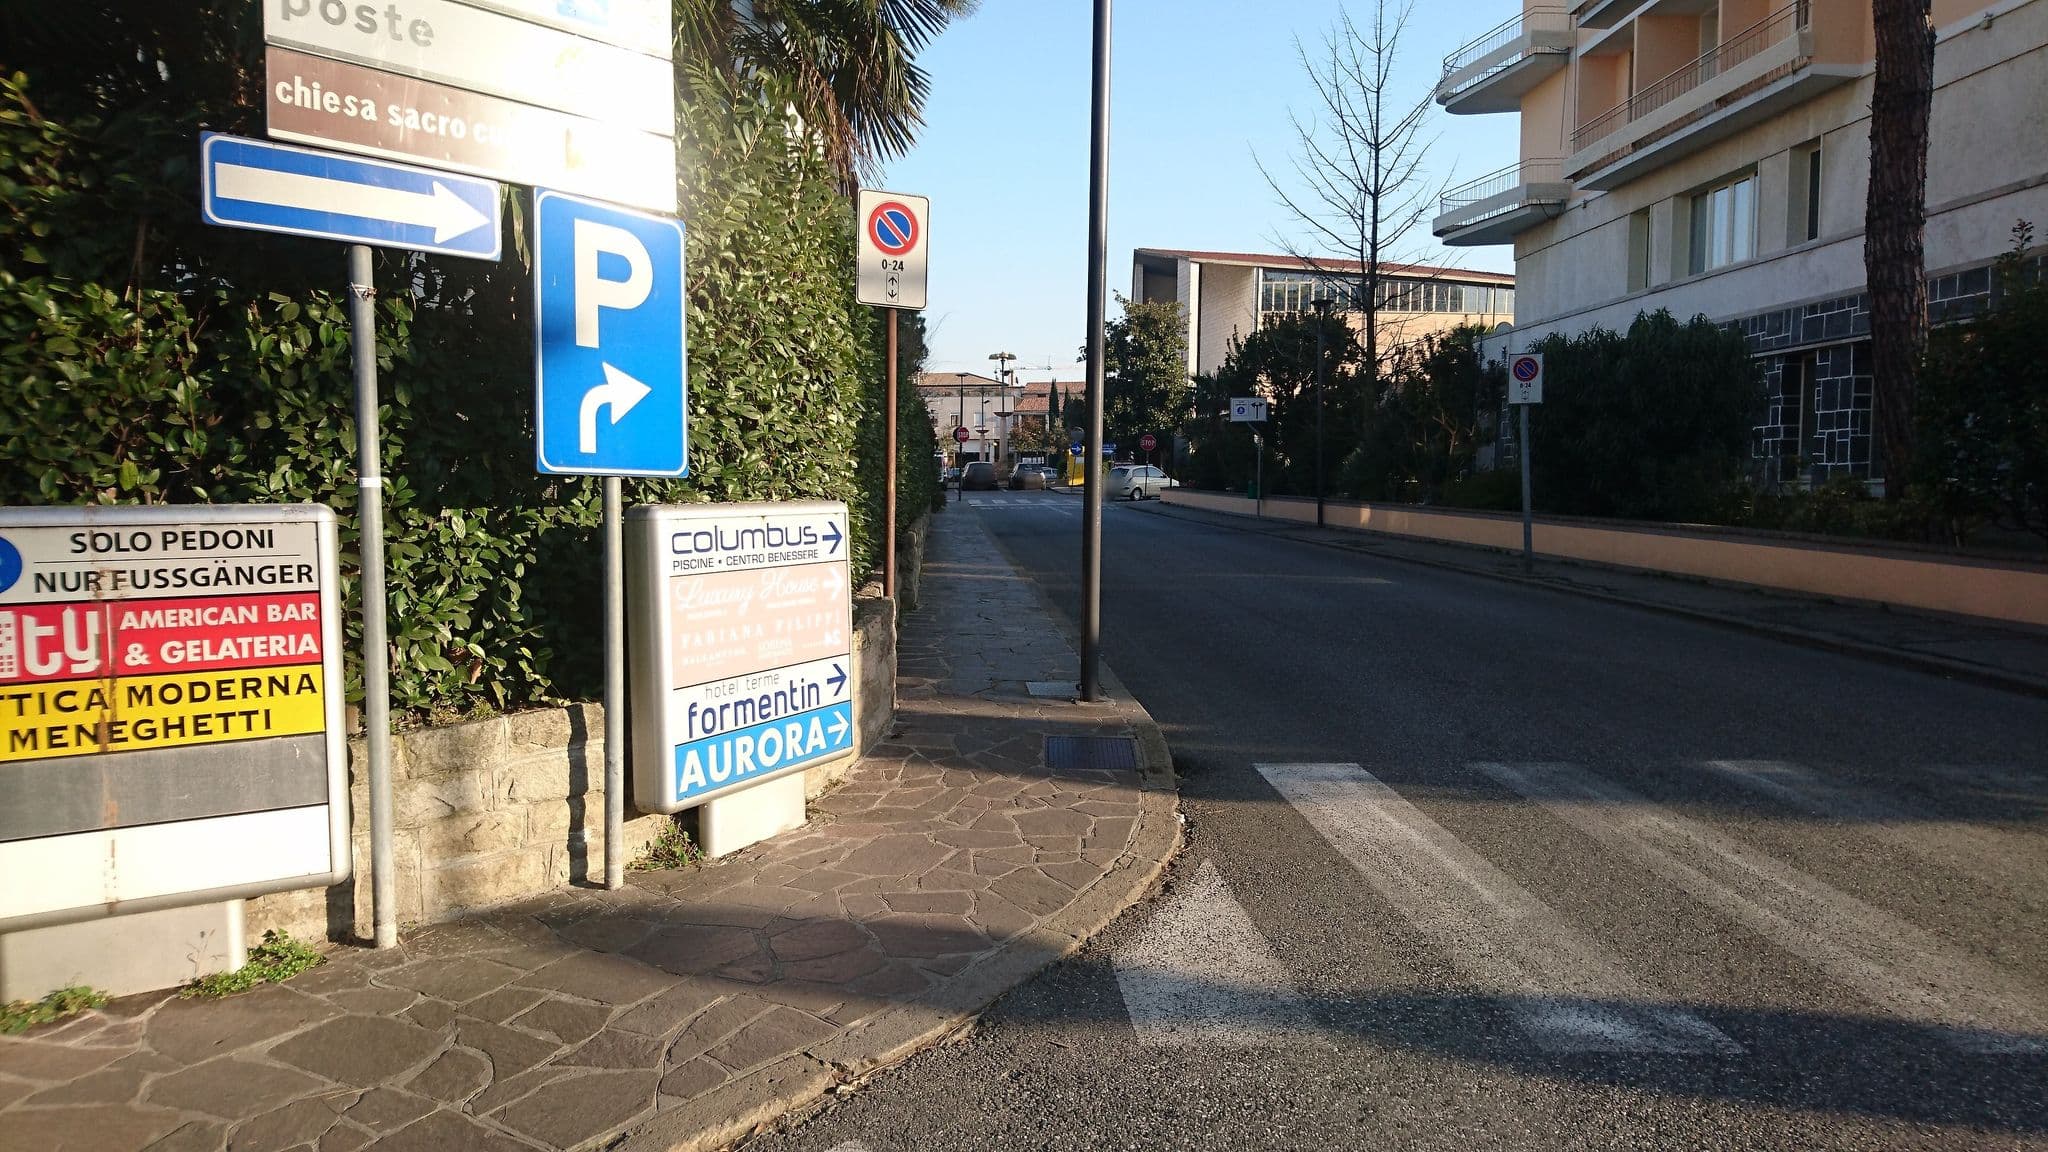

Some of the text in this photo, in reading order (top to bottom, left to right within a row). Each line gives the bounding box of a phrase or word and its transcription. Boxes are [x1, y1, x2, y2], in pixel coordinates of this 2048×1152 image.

[281, 0, 434, 47] poste
[275, 76, 377, 121] chiesa
[387, 103, 467, 139] sacro
[882, 259, 904, 271] 0-24
[574, 218, 654, 349] P
[1140, 439, 1155, 447] STOP
[70, 529, 275, 554] SOLO PEDONI
[671, 523, 818, 555] columbus
[34, 560, 314, 593] NUR FUSSGÄNGER
[672, 549, 819, 571] PISCINE CENTRO BENESSERE
[119, 602, 316, 631] AMERICAN BAR
[124, 633, 320, 667] & GELATERIA
[0, 673, 317, 717] TICA MODERNA
[705, 673, 780, 700] hotel terme
[688, 678, 820, 738] formentin
[9, 708, 272, 753] MENEGHETTI
[679, 715, 827, 794] AURORA
